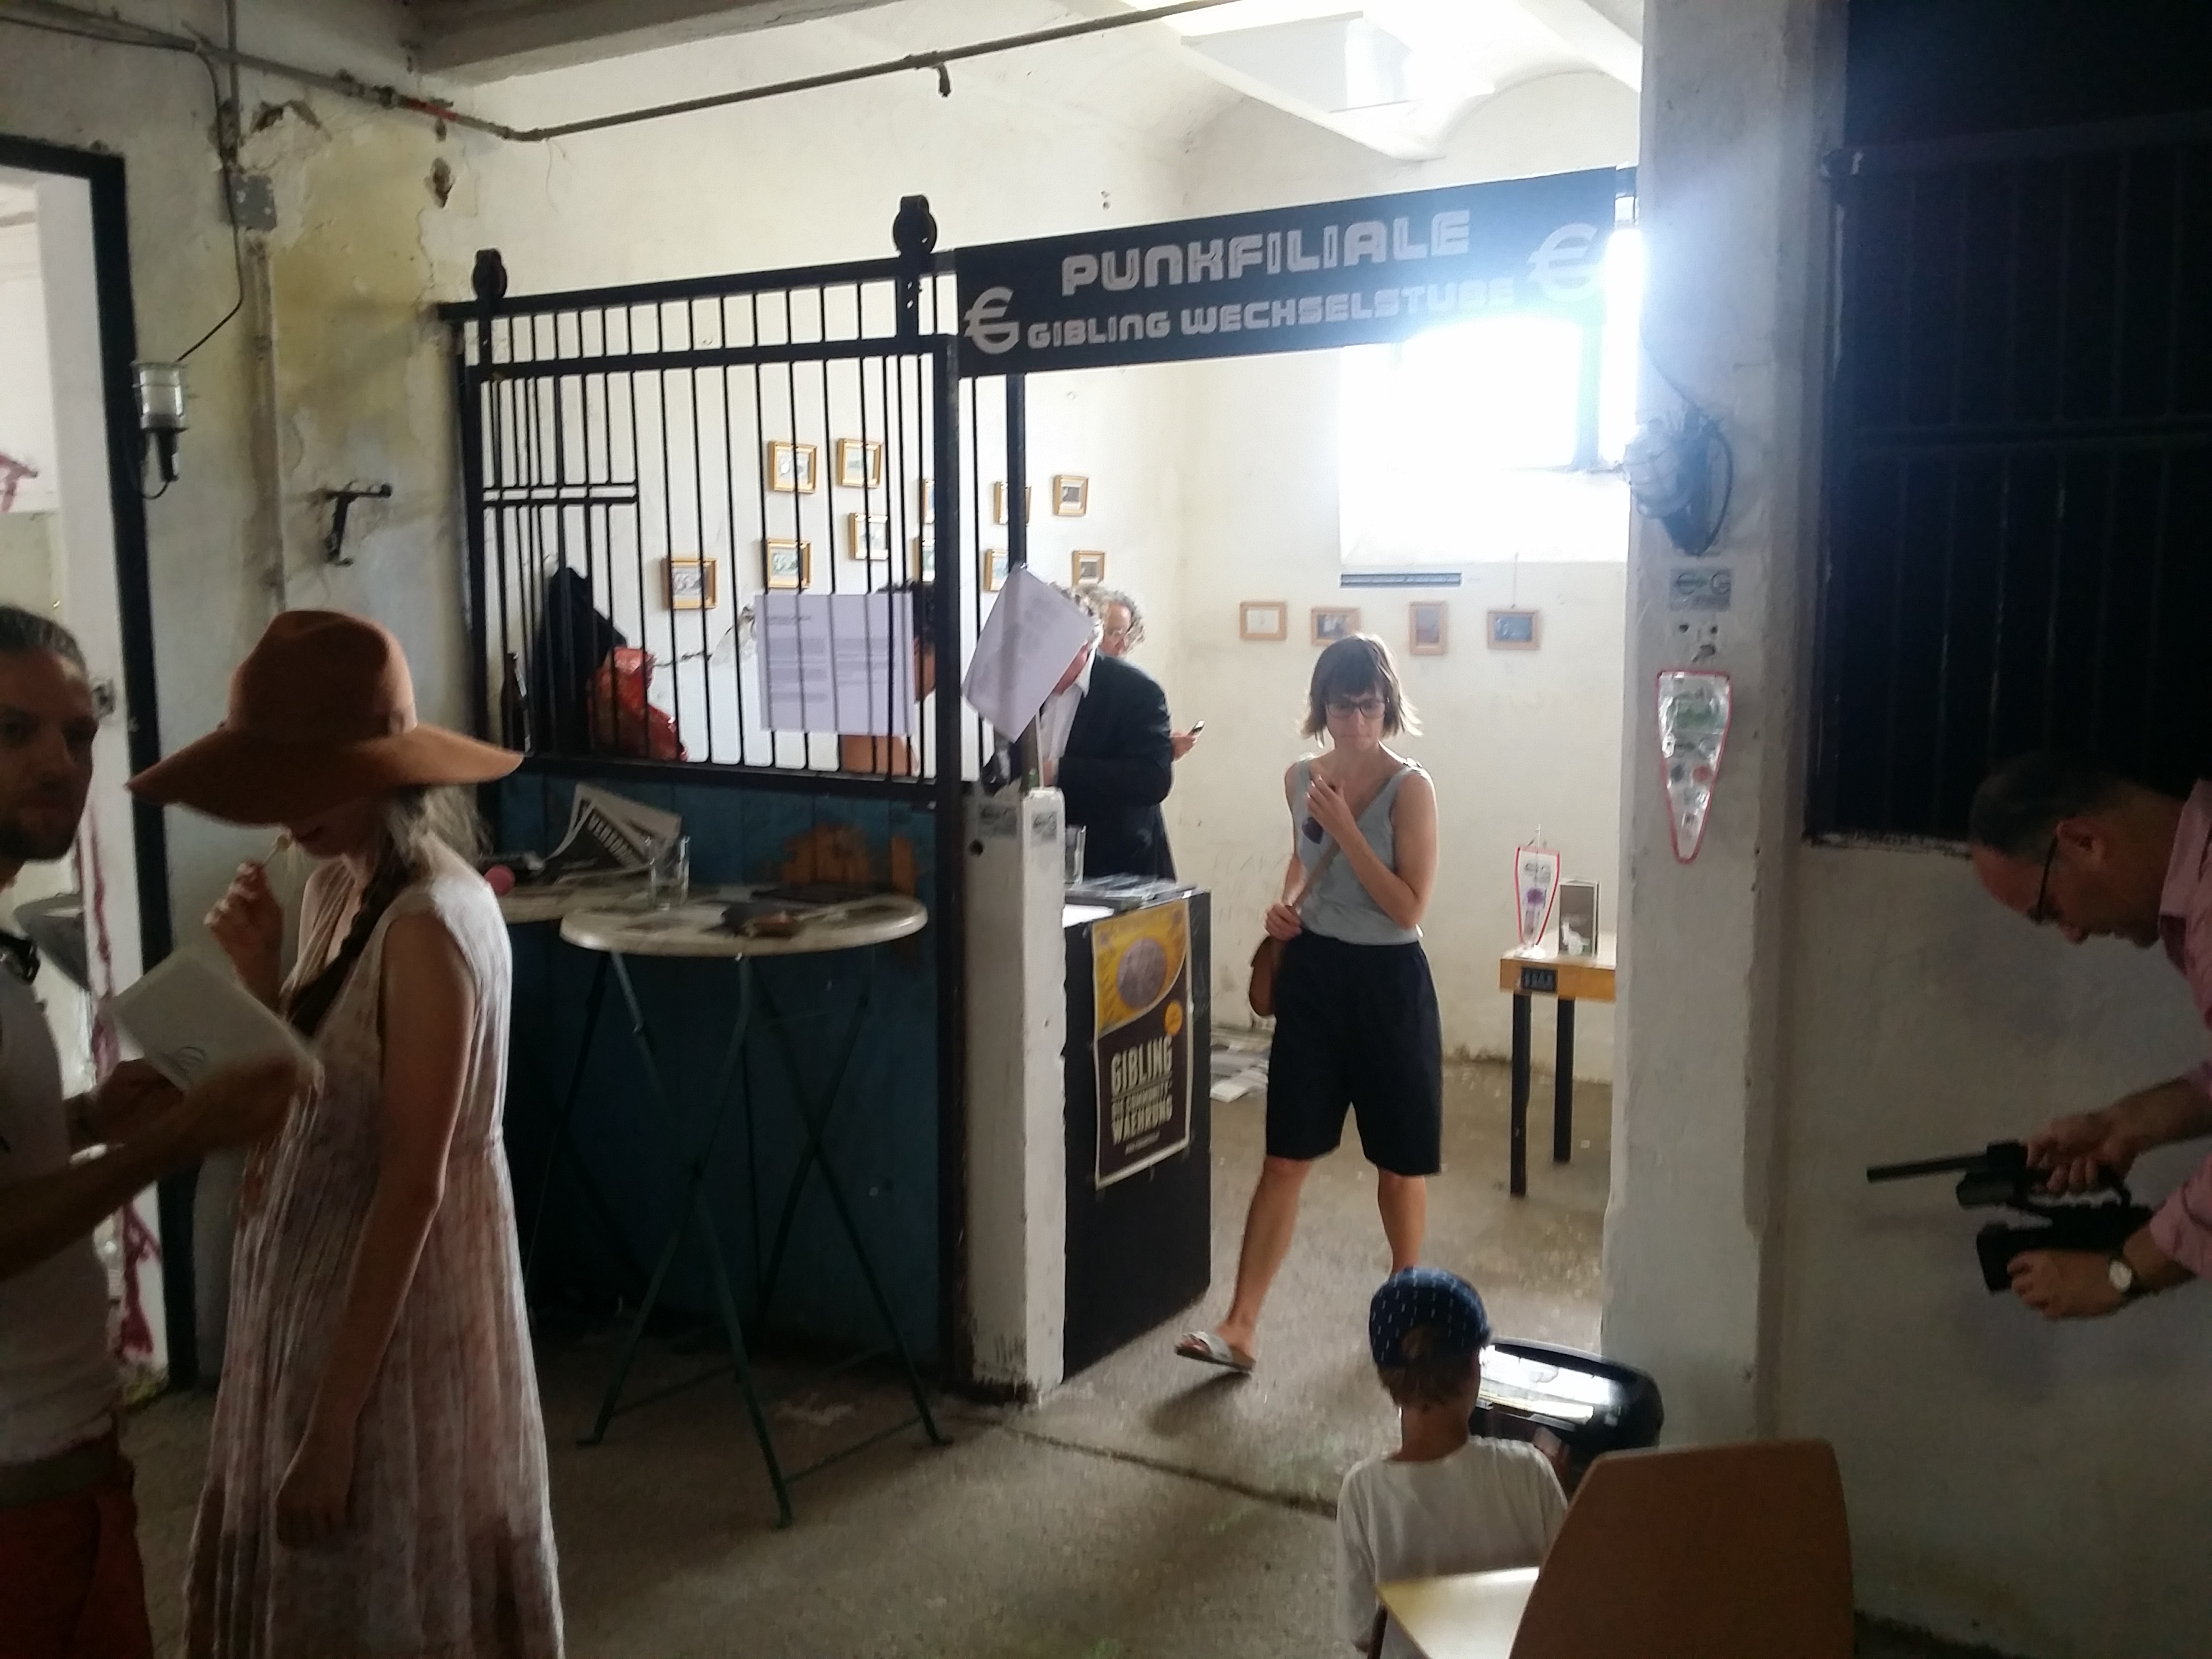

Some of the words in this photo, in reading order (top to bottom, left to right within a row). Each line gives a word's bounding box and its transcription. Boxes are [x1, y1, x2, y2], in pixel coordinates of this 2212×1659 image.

[1061, 210, 1470, 296] PUNKFILIALE
[1027, 312, 1171, 350] GIBLING
[1181, 279, 1514, 338] WECHSELSTUBE
[1111, 1035, 1172, 1094] GIBLING
